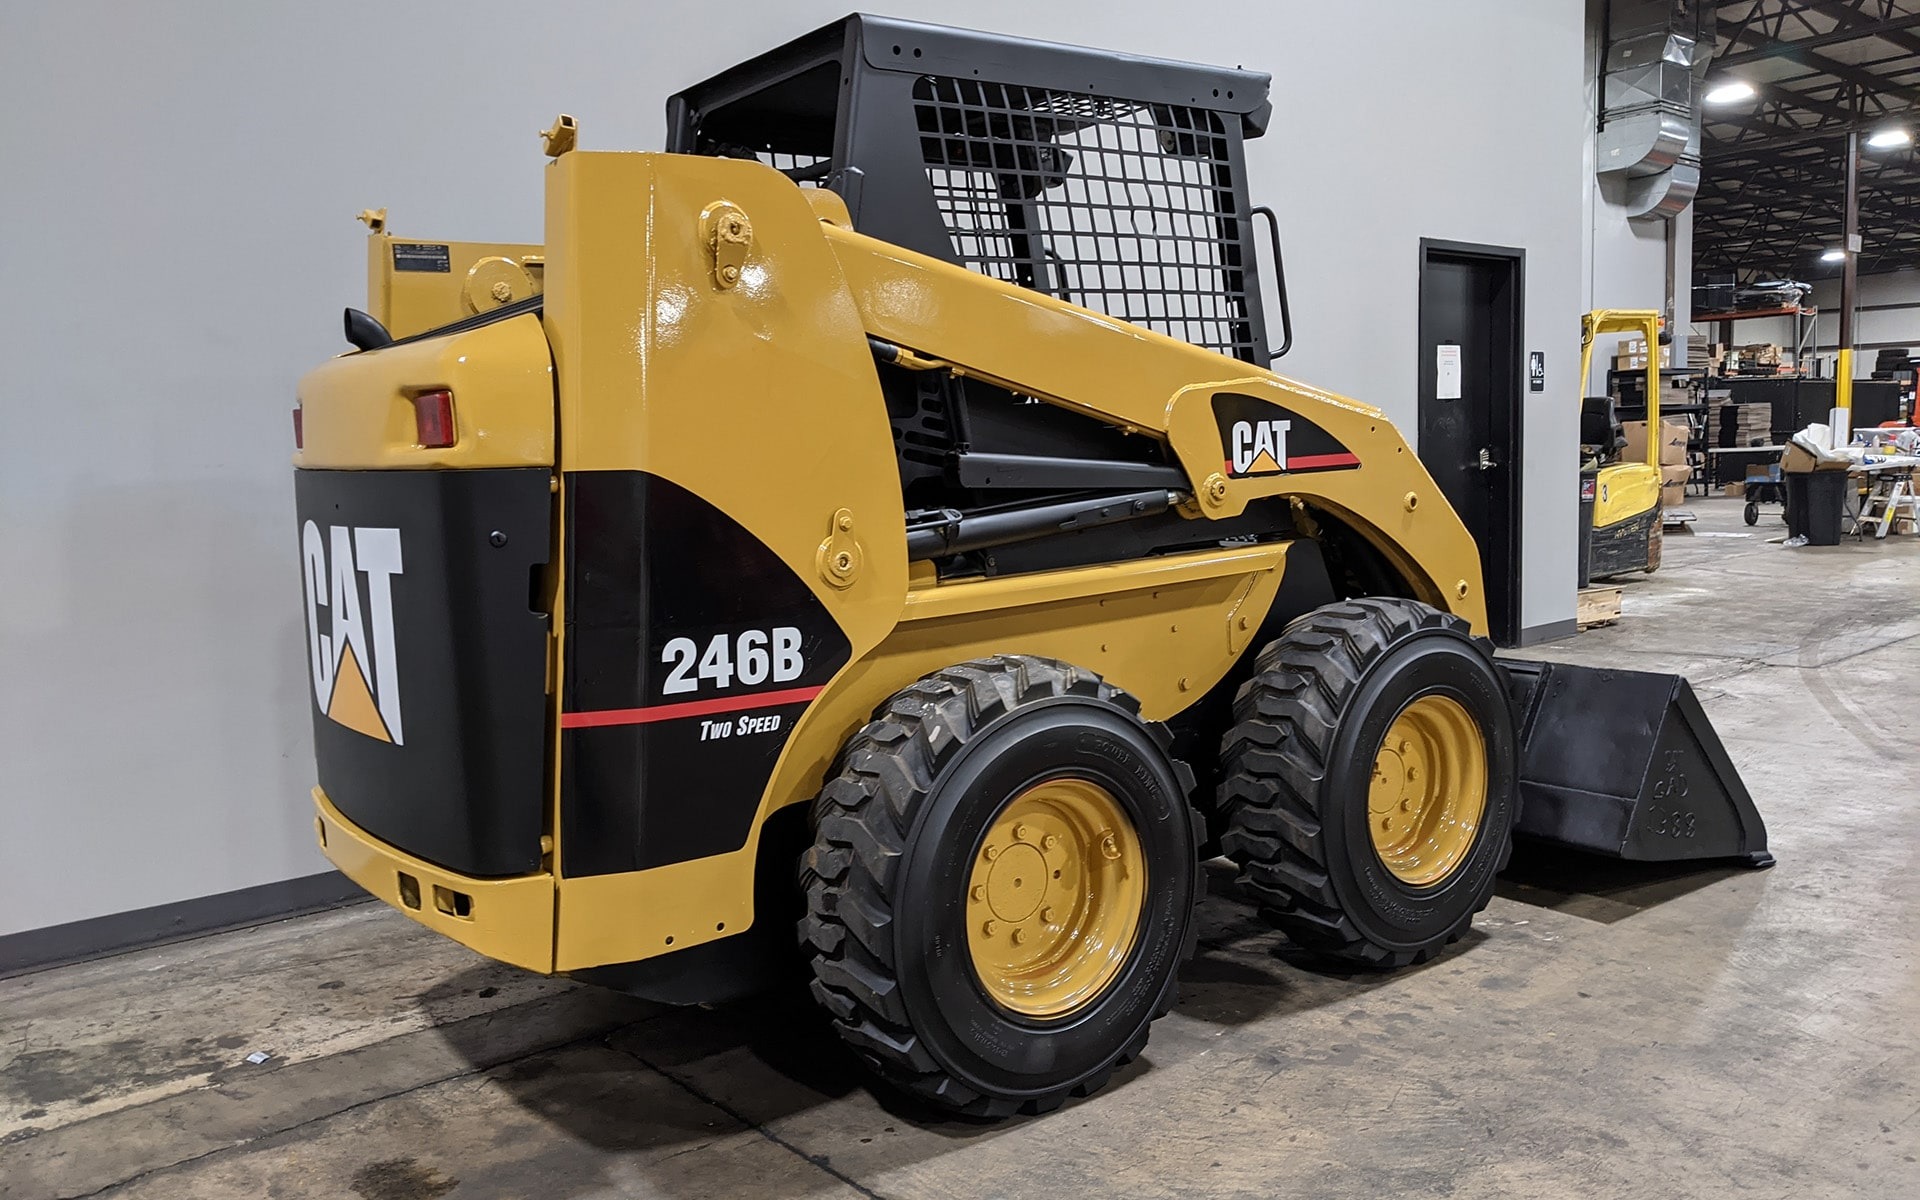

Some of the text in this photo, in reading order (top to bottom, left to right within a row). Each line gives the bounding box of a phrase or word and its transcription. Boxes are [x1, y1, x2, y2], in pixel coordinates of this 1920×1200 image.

[1232, 420, 1291, 474] CAT
[1602, 484, 1608, 502] 3
[303, 519, 404, 746] CAT
[661, 626, 804, 695] 246B
